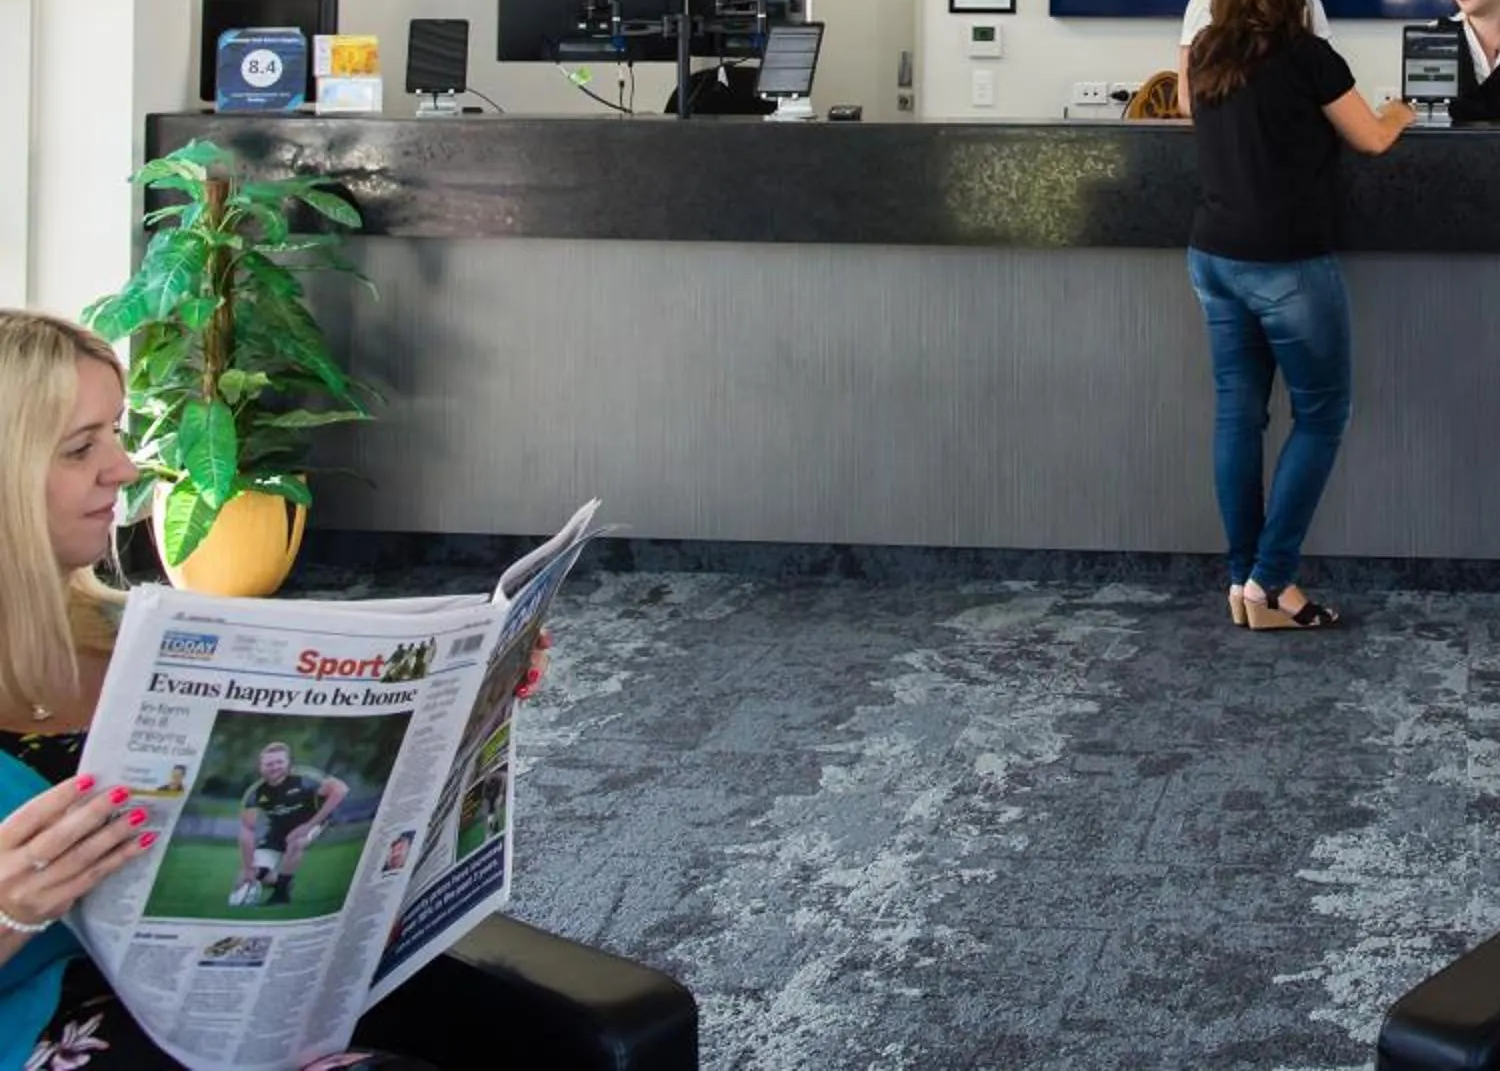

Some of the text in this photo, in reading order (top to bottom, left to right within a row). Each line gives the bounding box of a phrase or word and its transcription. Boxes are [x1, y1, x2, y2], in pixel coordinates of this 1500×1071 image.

[248, 59, 276, 75] 8.4
[296, 649, 385, 681] Sport
[147, 672, 418, 709] Evans happy to be home
